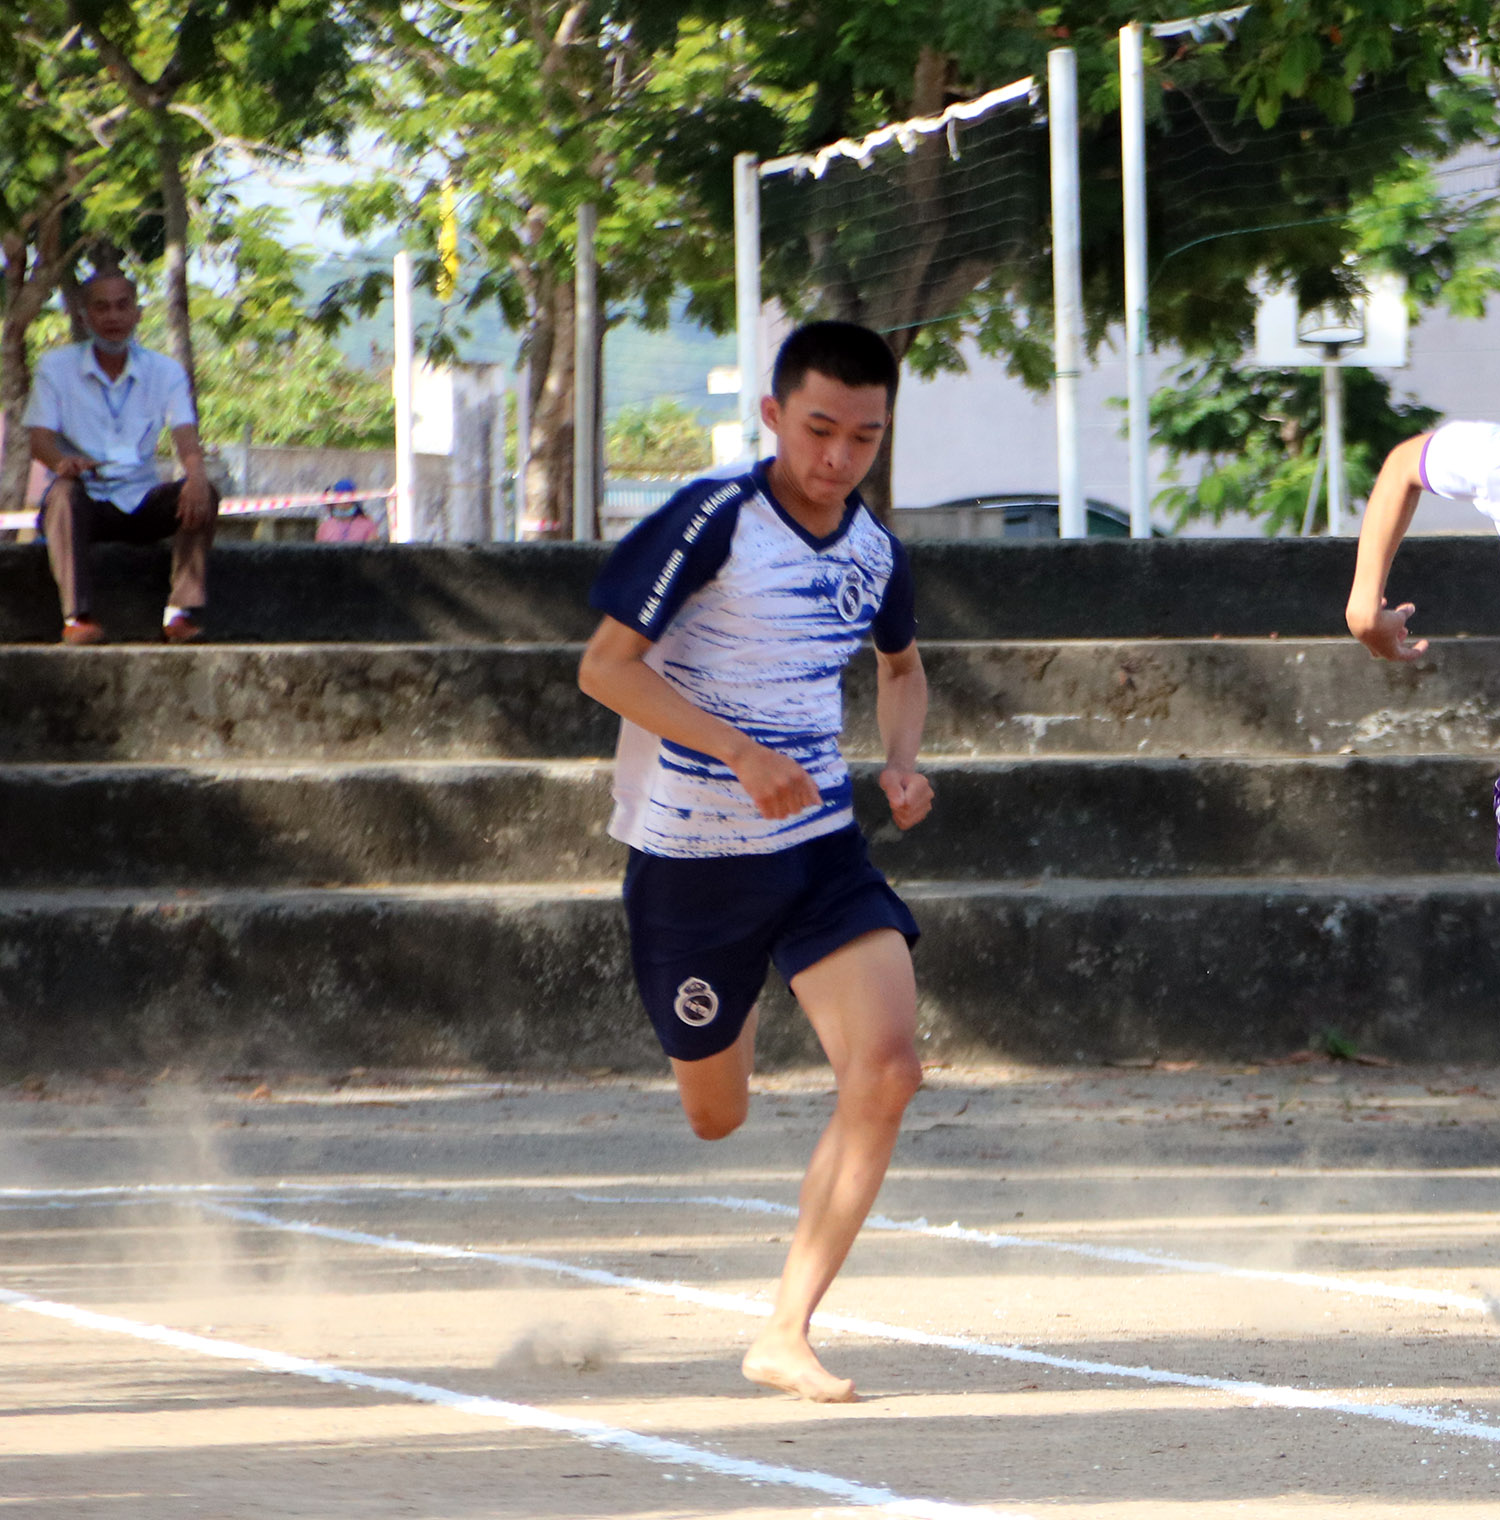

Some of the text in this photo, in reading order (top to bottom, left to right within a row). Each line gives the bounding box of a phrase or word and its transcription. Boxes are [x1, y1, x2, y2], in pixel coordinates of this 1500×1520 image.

[682, 481, 742, 544] REAL MADRID
[638, 549, 685, 627] REAL MADRID
